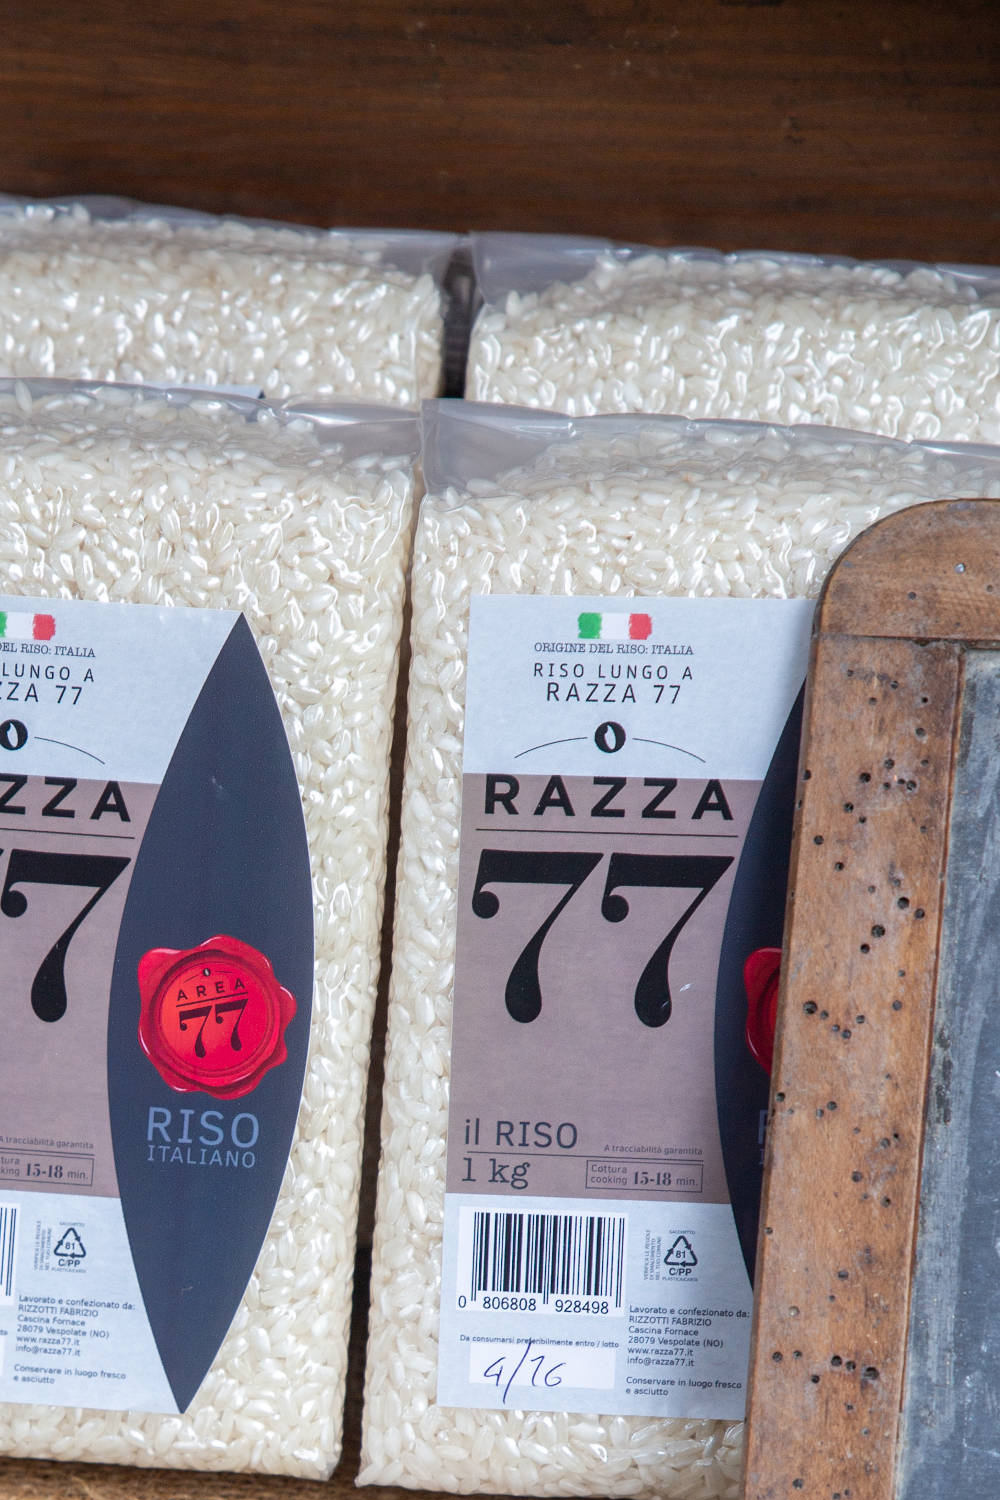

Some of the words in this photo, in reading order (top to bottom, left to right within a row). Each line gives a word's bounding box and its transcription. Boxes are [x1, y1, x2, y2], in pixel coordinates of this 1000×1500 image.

[20, 643, 52, 655] RISO:
[54, 645, 96, 658] ITALIA
[534, 642, 586, 654] ORIGINE
[589, 643, 614, 654] DEL
[616, 643, 649, 655] RISO:
[651, 644, 694, 656] ITALIA
[2, 662, 71, 681] LUNGO
[83, 668, 95, 683] A
[533, 662, 585, 678] RISO
[598, 664, 668, 680] LUNGO
[682, 666, 693, 681] A
[55, 685, 83, 705] 77
[546, 682, 636, 704] RAZZA
[653, 684, 681, 704] 77
[484, 773, 734, 821] RAZZA
[471, 848, 735, 1028] 77
[177, 978, 245, 1001] AREA
[178, 998, 249, 1058] 77
[147, 1106, 260, 1148] RISO
[464, 1118, 480, 1146] il
[496, 1120, 578, 1149] RISO
[147, 1144, 256, 1169] ITALIANO
[25, 1163, 64, 1179] 15-18
[68, 1169, 89, 1180] min.
[461, 1157, 477, 1182] 1
[488, 1158, 531, 1190] kg
[590, 1164, 628, 1174] Cottura
[590, 1174, 628, 1186] cooking
[633, 1170, 672, 1186] 15-18
[676, 1175, 699, 1187] min.
[65, 1242, 76, 1251] 81
[675, 1250, 687, 1259] 81
[668, 1267, 693, 1276] C/PP
[18, 1296, 55, 1305] Lavorato
[65, 1297, 120, 1310] confezionato
[458, 1295, 467, 1309] 0
[482, 1296, 537, 1311] 806808
[555, 1299, 609, 1314] 928498
[18, 1304, 58, 1313] RIZZOTTI
[59, 1306, 99, 1317] FABRIZIO
[629, 1305, 667, 1314] Lavorato
[677, 1307, 734, 1319] confezionato
[736, 1309, 750, 1319] da:
[17, 1313, 50, 1324] Cascina
[52, 1316, 86, 1327] Fornace
[629, 1316, 670, 1325] RIZZOTTI
[671, 1317, 712, 1327] FABRIZIO
[16, 1324, 43, 1334] 28079
[45, 1325, 87, 1338] Vespolate
[89, 1329, 110, 1340] (NO)
[628, 1325, 662, 1336] Cascina
[664, 1327, 699, 1337] Fornace
[16, 1336, 80, 1347] www.razza77.it
[472, 1335, 515, 1344] consumarsi
[576, 1340, 595, 1348] entro
[602, 1340, 619, 1349] lotto
[628, 1336, 656, 1345] 28079
[658, 1337, 701, 1348] Vespolate
[703, 1338, 724, 1348] (NO)
[15, 1344, 81, 1357] info@razza77.it
[627, 1347, 694, 1357] www.razza77.it
[627, 1357, 695, 1368] info@razza77.it
[13, 1363, 62, 1375] Conservare
[64, 1365, 73, 1376] in
[74, 1366, 98, 1379] luogo
[100, 1369, 127, 1380] fresco
[484, 1339, 567, 1405] 4/16
[21, 1375, 55, 1385] asciutto
[626, 1376, 675, 1386] Conservare
[678, 1378, 686, 1387] in
[688, 1378, 713, 1390] luogo
[714, 1379, 742, 1389] fresco
[633, 1387, 669, 1396] asciutto
